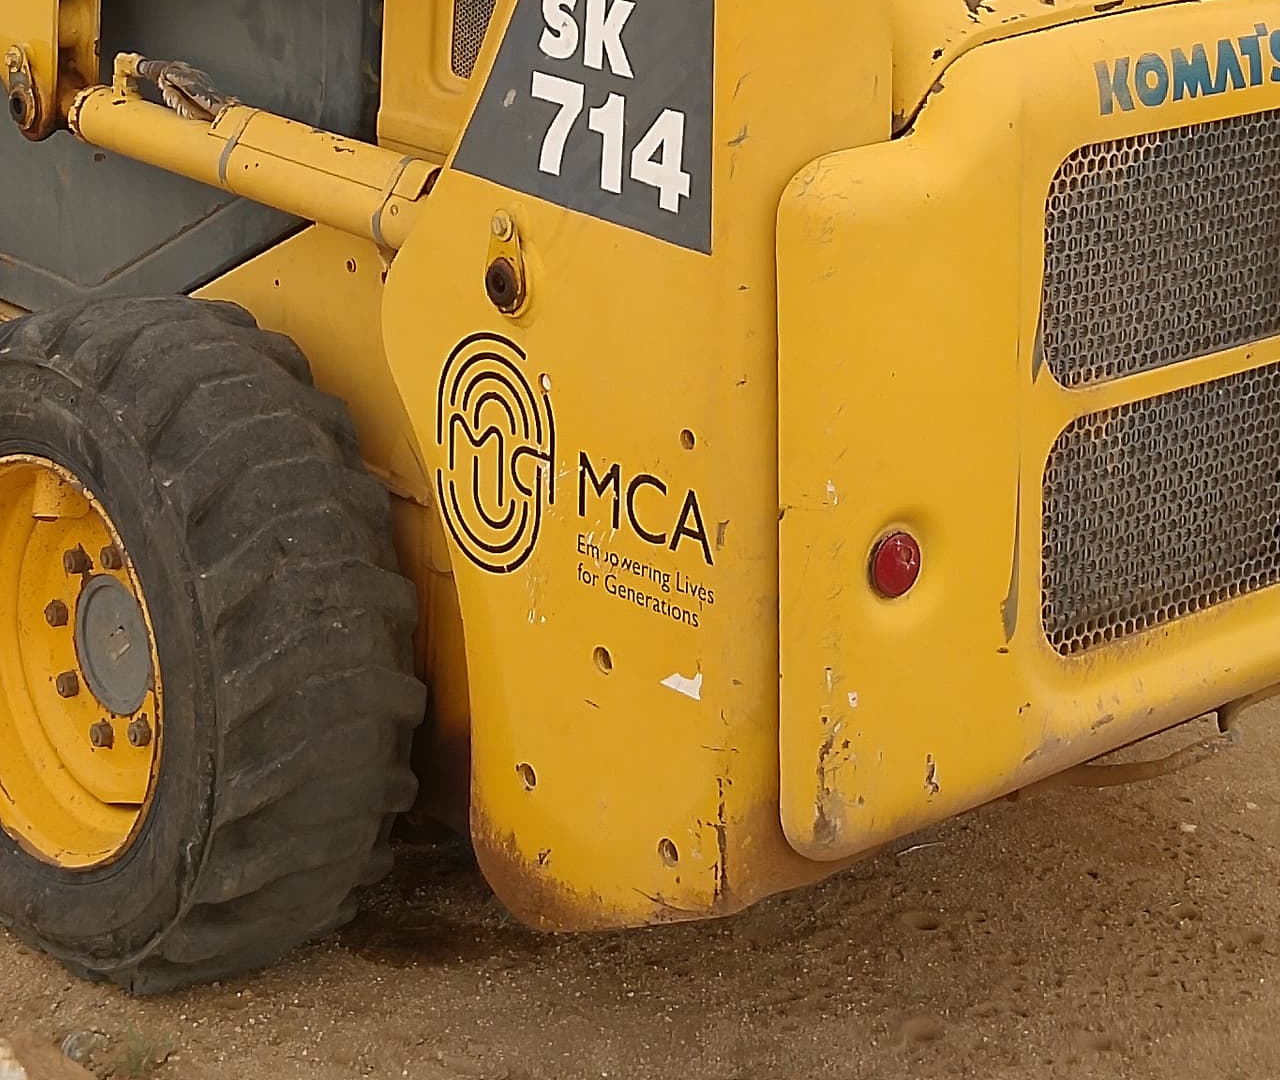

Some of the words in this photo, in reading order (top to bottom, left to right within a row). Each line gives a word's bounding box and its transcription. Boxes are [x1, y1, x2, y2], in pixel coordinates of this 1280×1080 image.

[530, 70, 692, 214] 714
[578, 450, 714, 567] MCA
[577, 562, 599, 587] for
[604, 574, 699, 628] Generations
[676, 571, 714, 605] Lives
